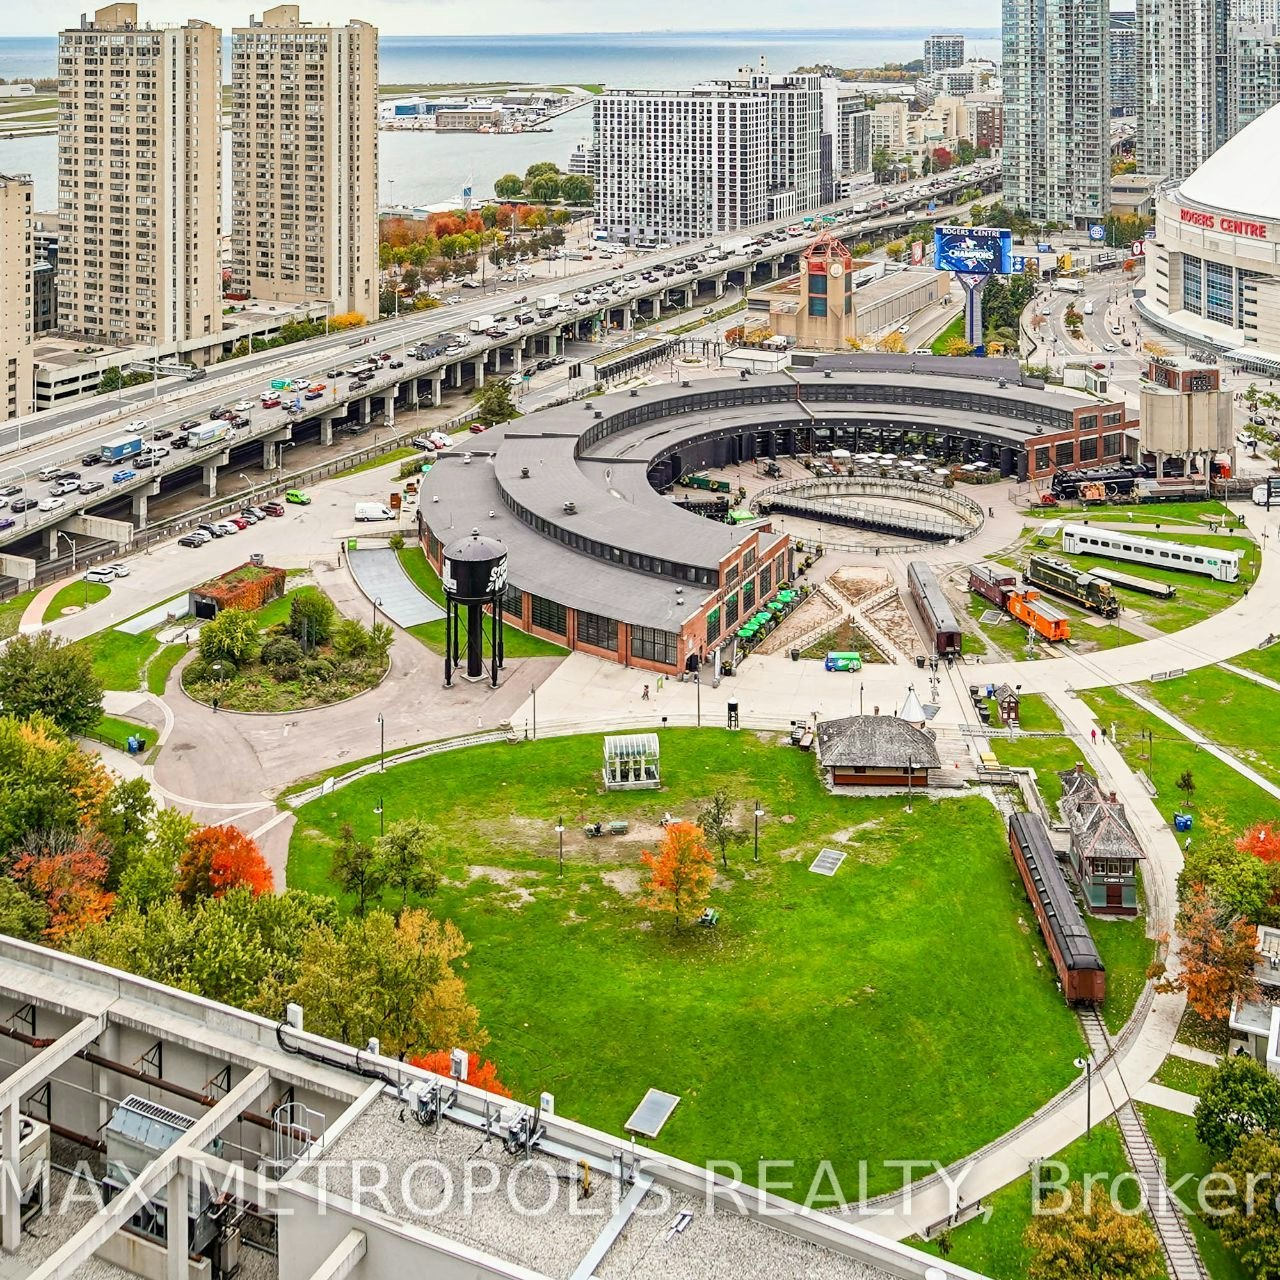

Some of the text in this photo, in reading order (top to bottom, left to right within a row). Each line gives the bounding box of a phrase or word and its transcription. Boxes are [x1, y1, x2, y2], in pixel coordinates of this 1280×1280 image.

[942, 228, 1000, 238] ROGERS CENTRE
[1180, 208, 1267, 239] ROGERS CENTRE
